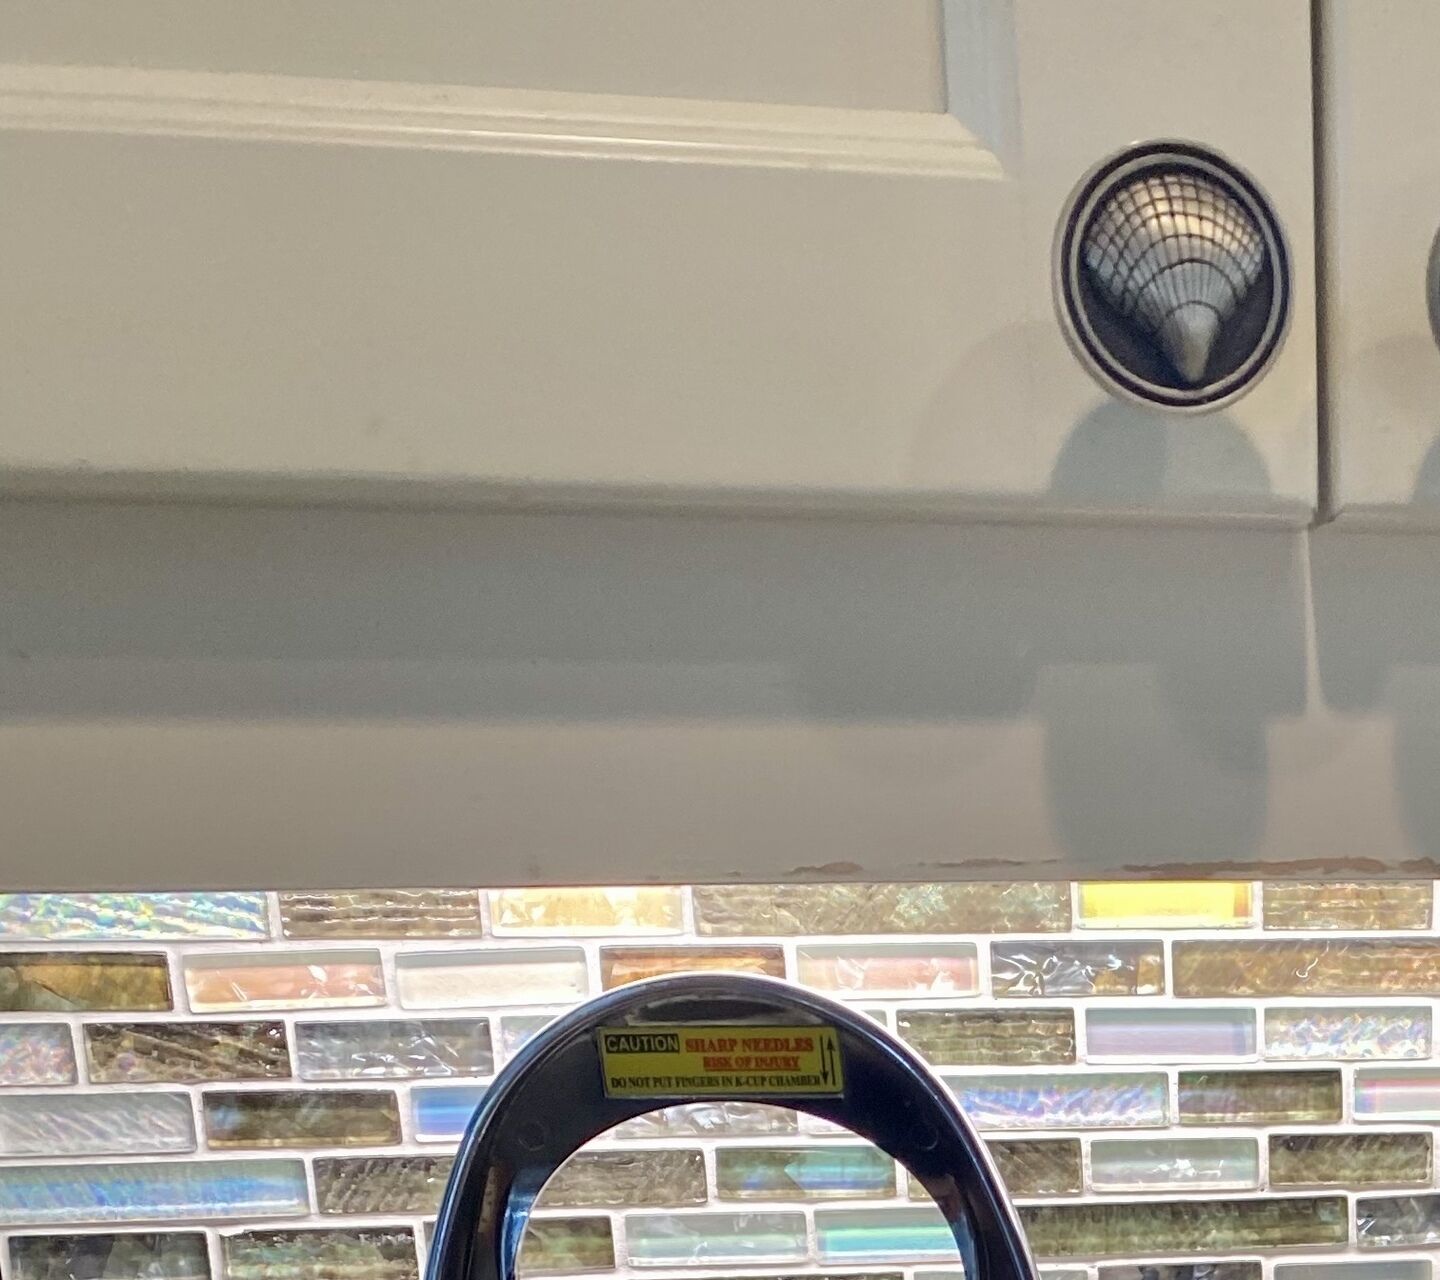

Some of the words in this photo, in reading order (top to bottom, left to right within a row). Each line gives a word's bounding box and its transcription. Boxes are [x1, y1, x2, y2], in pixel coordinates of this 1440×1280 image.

[606, 1034, 679, 1053] CAUTION
[685, 1037, 738, 1053] SHARP
[742, 1038, 814, 1052] NEEDLES
[703, 1056, 735, 1069] RISK
[736, 1056, 752, 1069] OF
[754, 1056, 801, 1069] INJURY
[611, 1076, 628, 1089] DO
[628, 1076, 652, 1088] NOT
[653, 1076, 673, 1088] PUT
[675, 1075, 720, 1087] FINGERS
[721, 1075, 735, 1087] IN
[735, 1075, 767, 1087] K-CUP
[768, 1074, 821, 1087] CHAMBER
